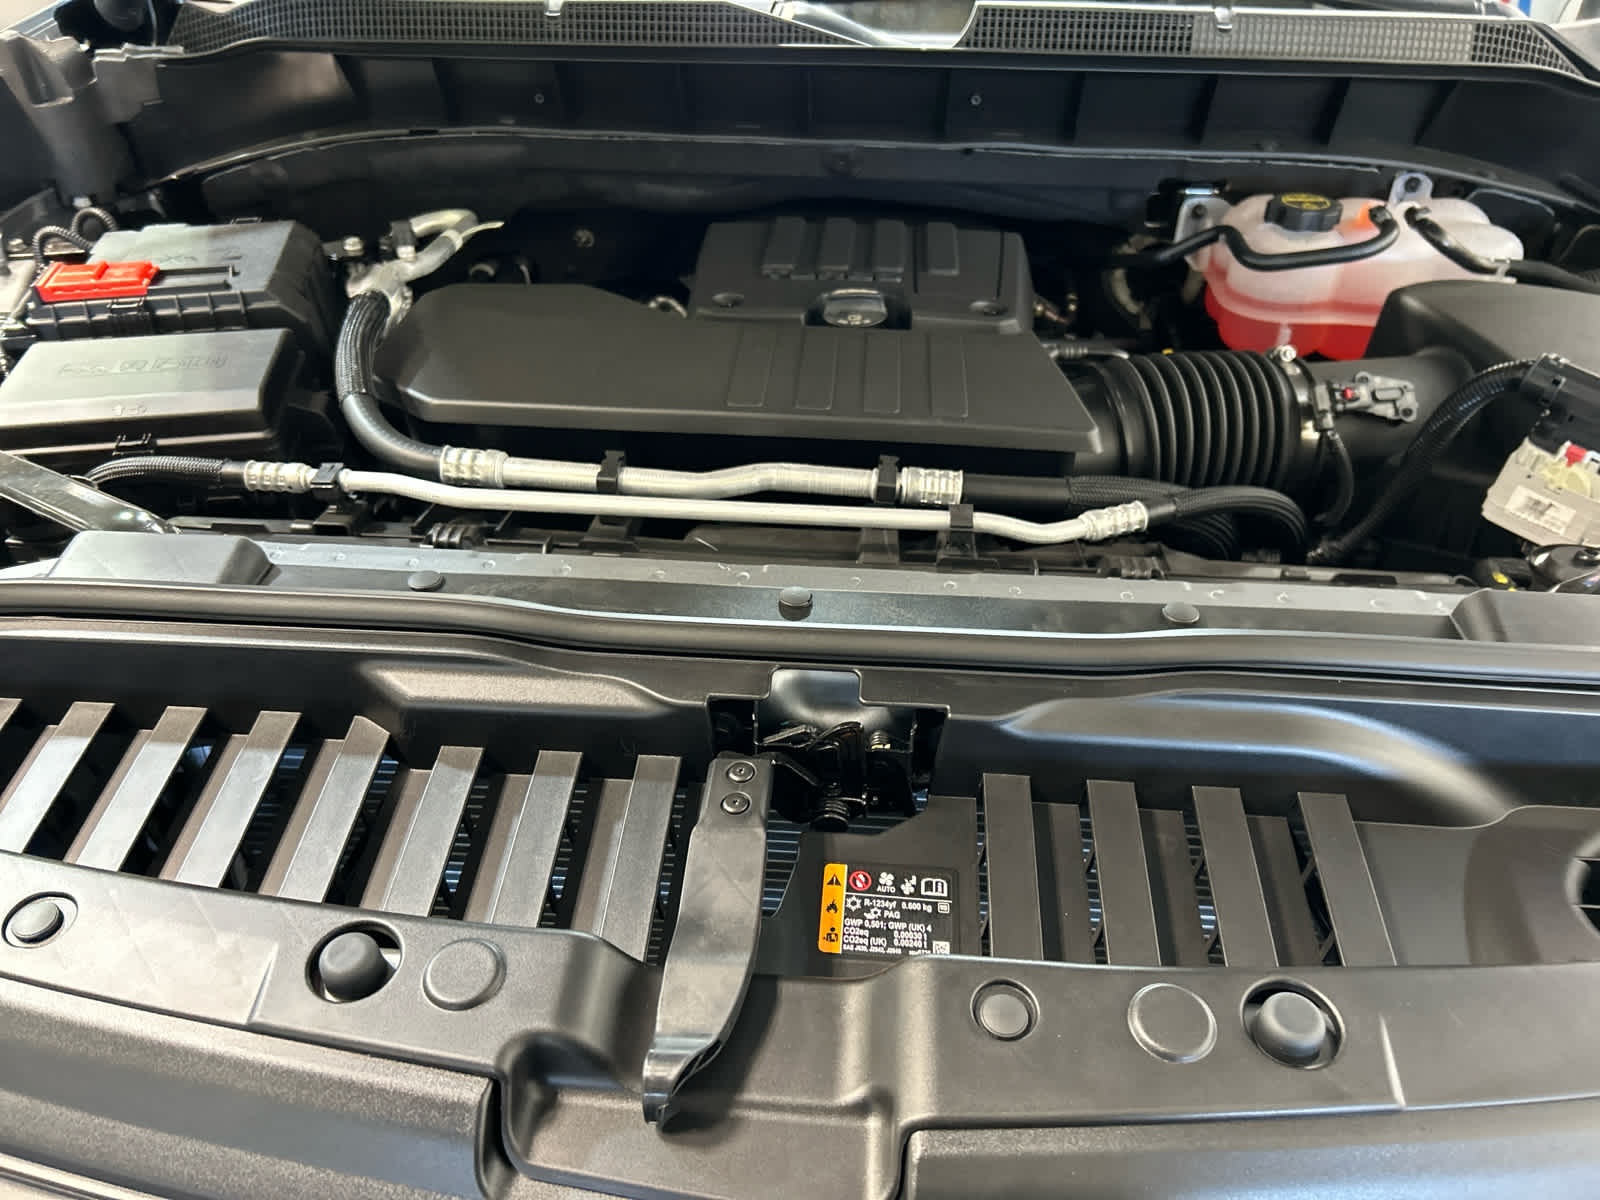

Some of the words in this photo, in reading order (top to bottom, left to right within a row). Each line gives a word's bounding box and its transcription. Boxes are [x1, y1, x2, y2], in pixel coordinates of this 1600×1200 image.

[864, 898, 897, 909] R-1234yf
[923, 902, 932, 912] kg
[884, 910, 900, 918] PAG
[844, 918, 863, 927] GWP
[888, 921, 907, 930] GWP
[909, 922, 925, 932] (UK)
[927, 924, 932, 932] 4
[844, 927, 869, 937] CO2eq
[843, 936, 868, 946] CO2eq
[870, 937, 886, 948] (UK)
